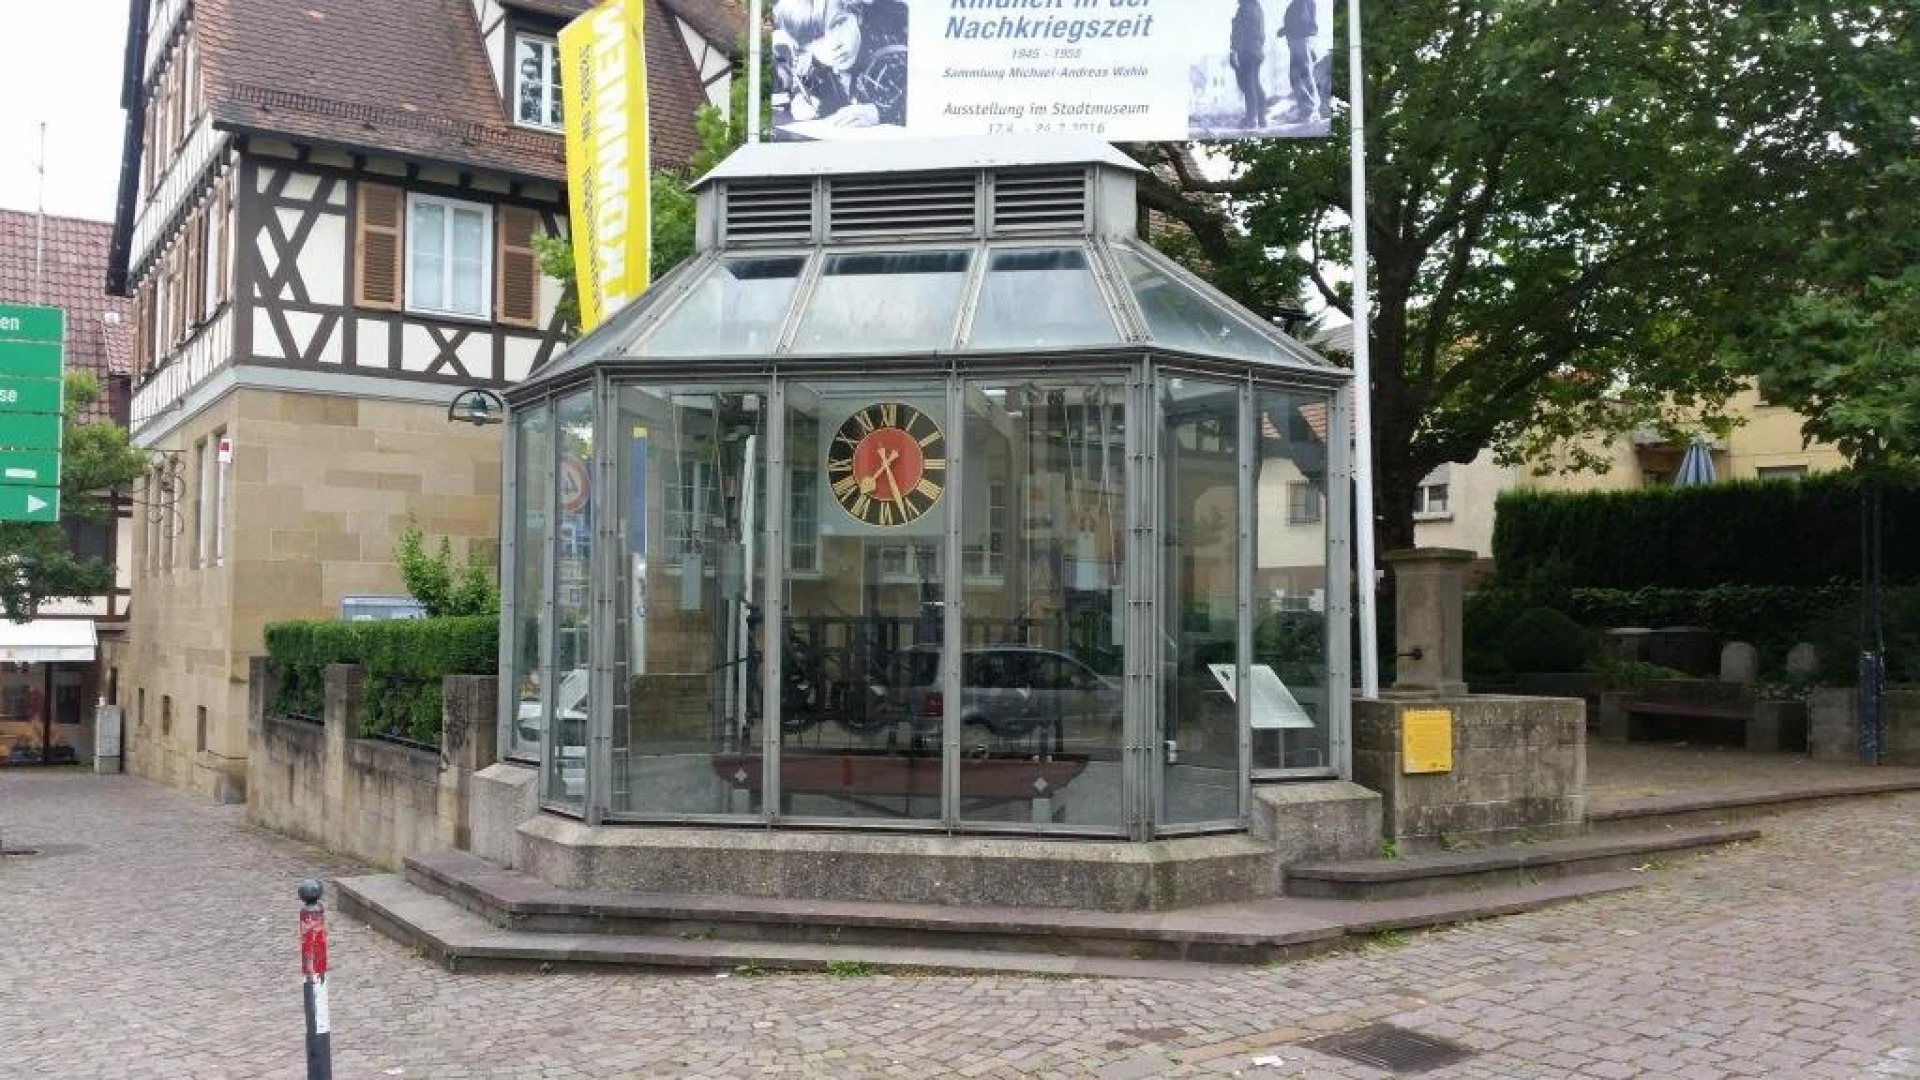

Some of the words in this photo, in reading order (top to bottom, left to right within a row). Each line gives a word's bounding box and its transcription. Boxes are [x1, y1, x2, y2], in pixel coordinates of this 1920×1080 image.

[944, 13, 1153, 43] Nachkriegszeit
[1011, 48, 1040, 58] 1945
[943, 67, 1005, 80] Sammlung
[1009, 66, 1108, 77] Michael-Andreas
[943, 101, 1024, 118] Ausstellung
[1030, 101, 1048, 115] im
[1052, 101, 1150, 115] Stadtmuseum
